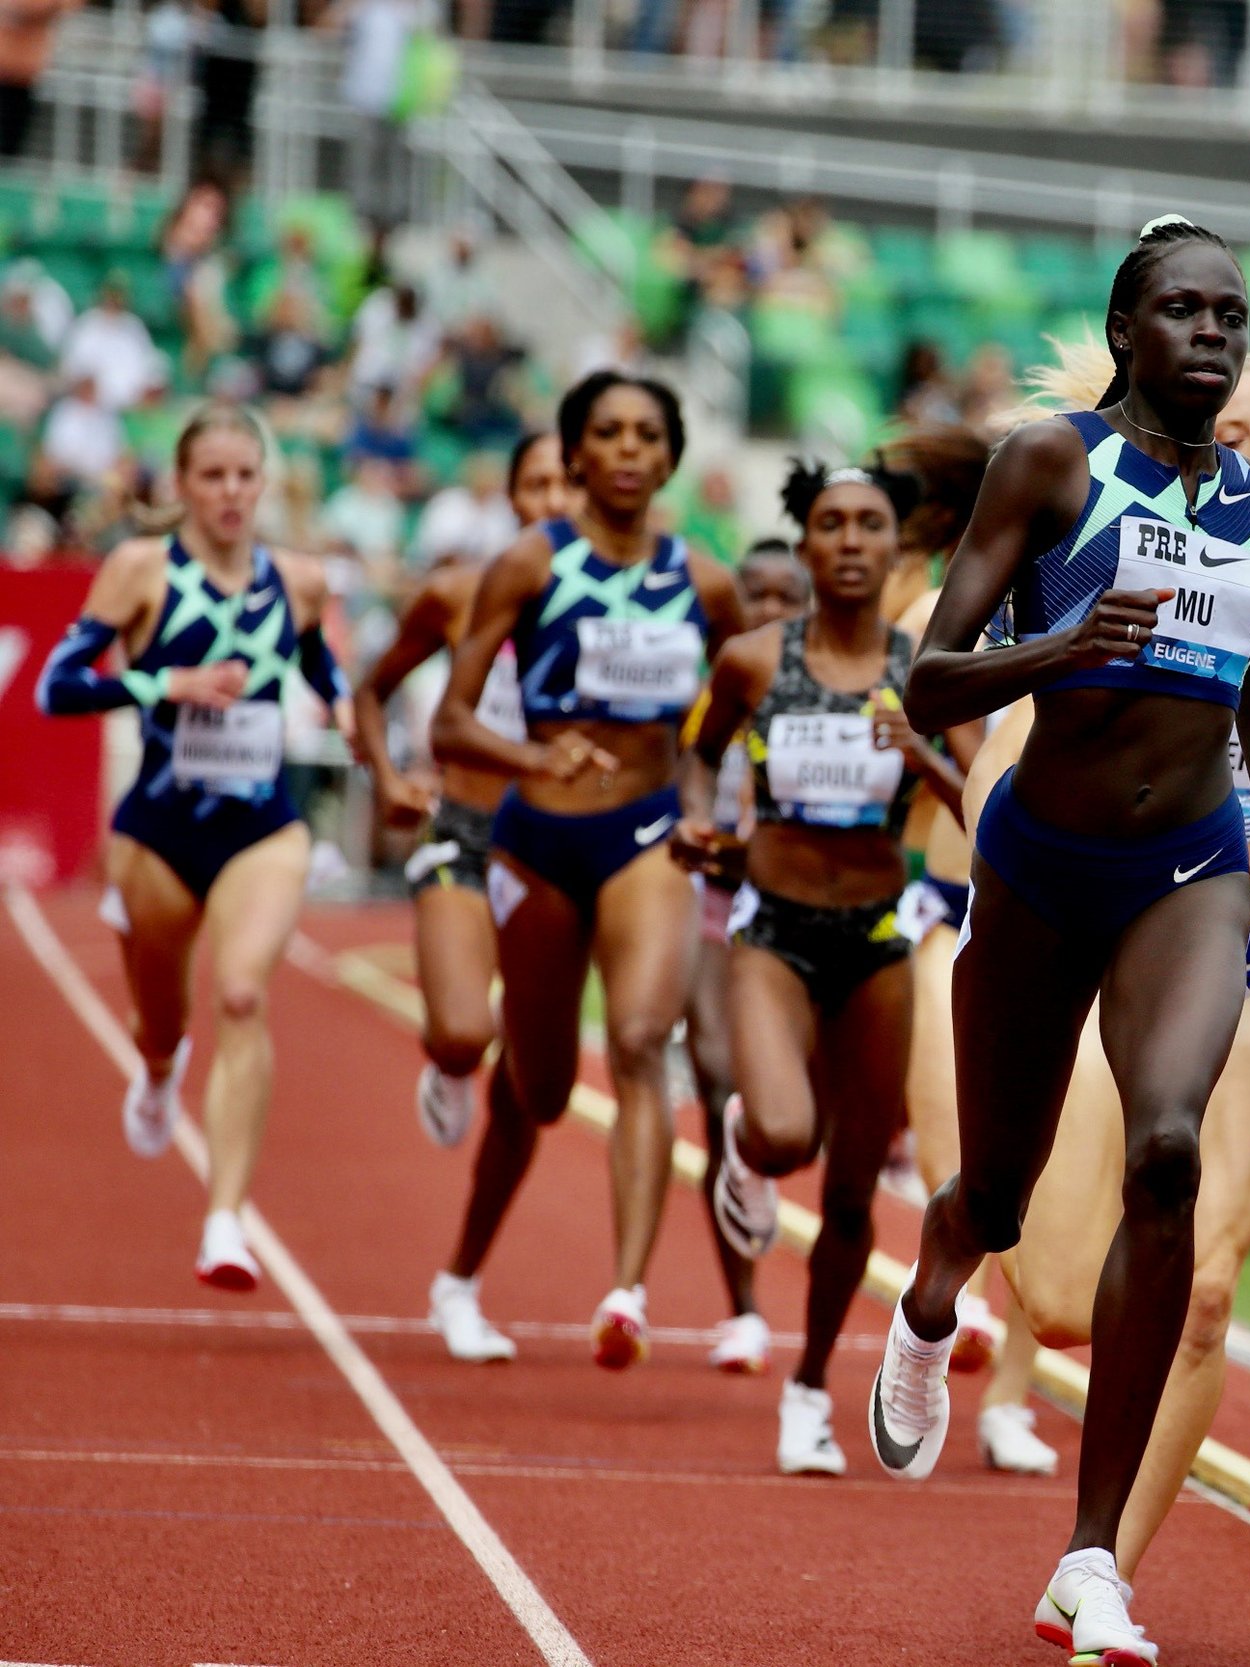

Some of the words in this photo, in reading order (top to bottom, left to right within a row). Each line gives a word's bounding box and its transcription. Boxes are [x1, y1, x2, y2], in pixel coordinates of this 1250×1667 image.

[1137, 523, 1187, 566] PRE
[1174, 587, 1215, 627] MU
[1154, 643, 1216, 670] EUGENE
